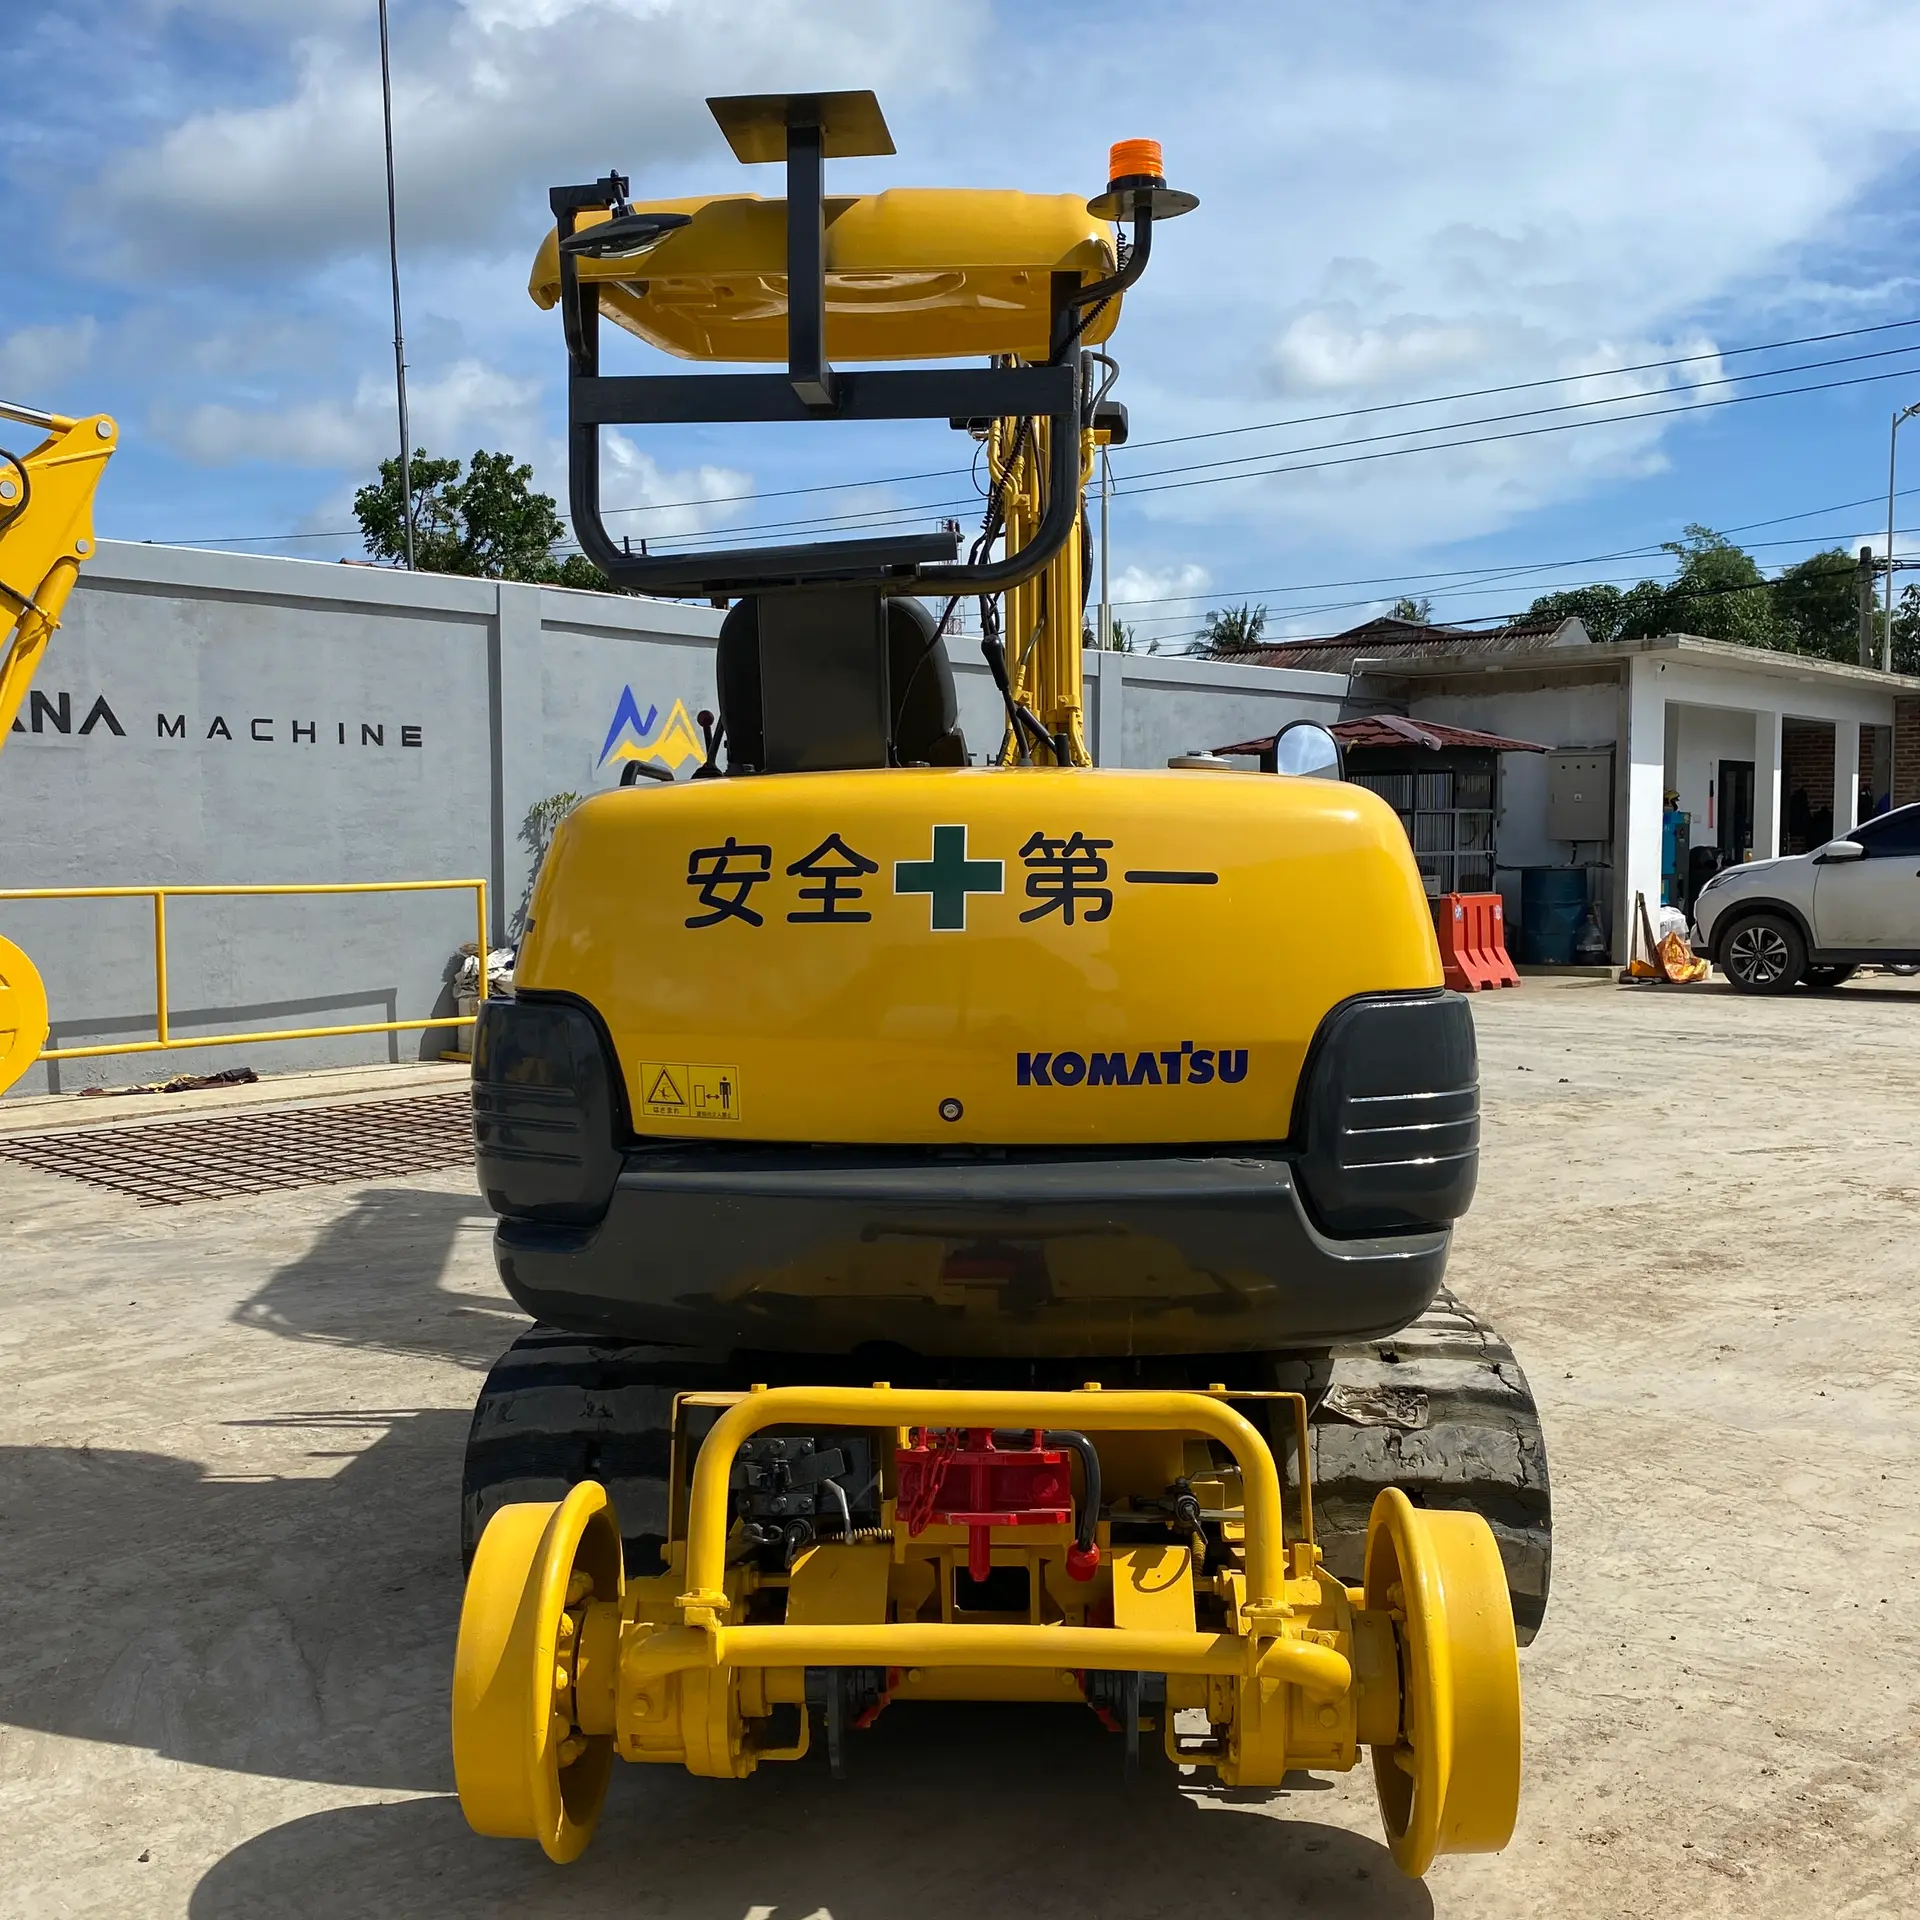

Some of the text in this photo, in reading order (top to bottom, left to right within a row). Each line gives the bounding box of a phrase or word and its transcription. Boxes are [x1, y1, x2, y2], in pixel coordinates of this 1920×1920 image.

[12, 690, 423, 747] NA MACHINE
[685, 831, 1219, 929] 安全 第一
[1017, 1040, 1249, 1087] KOMATSU
